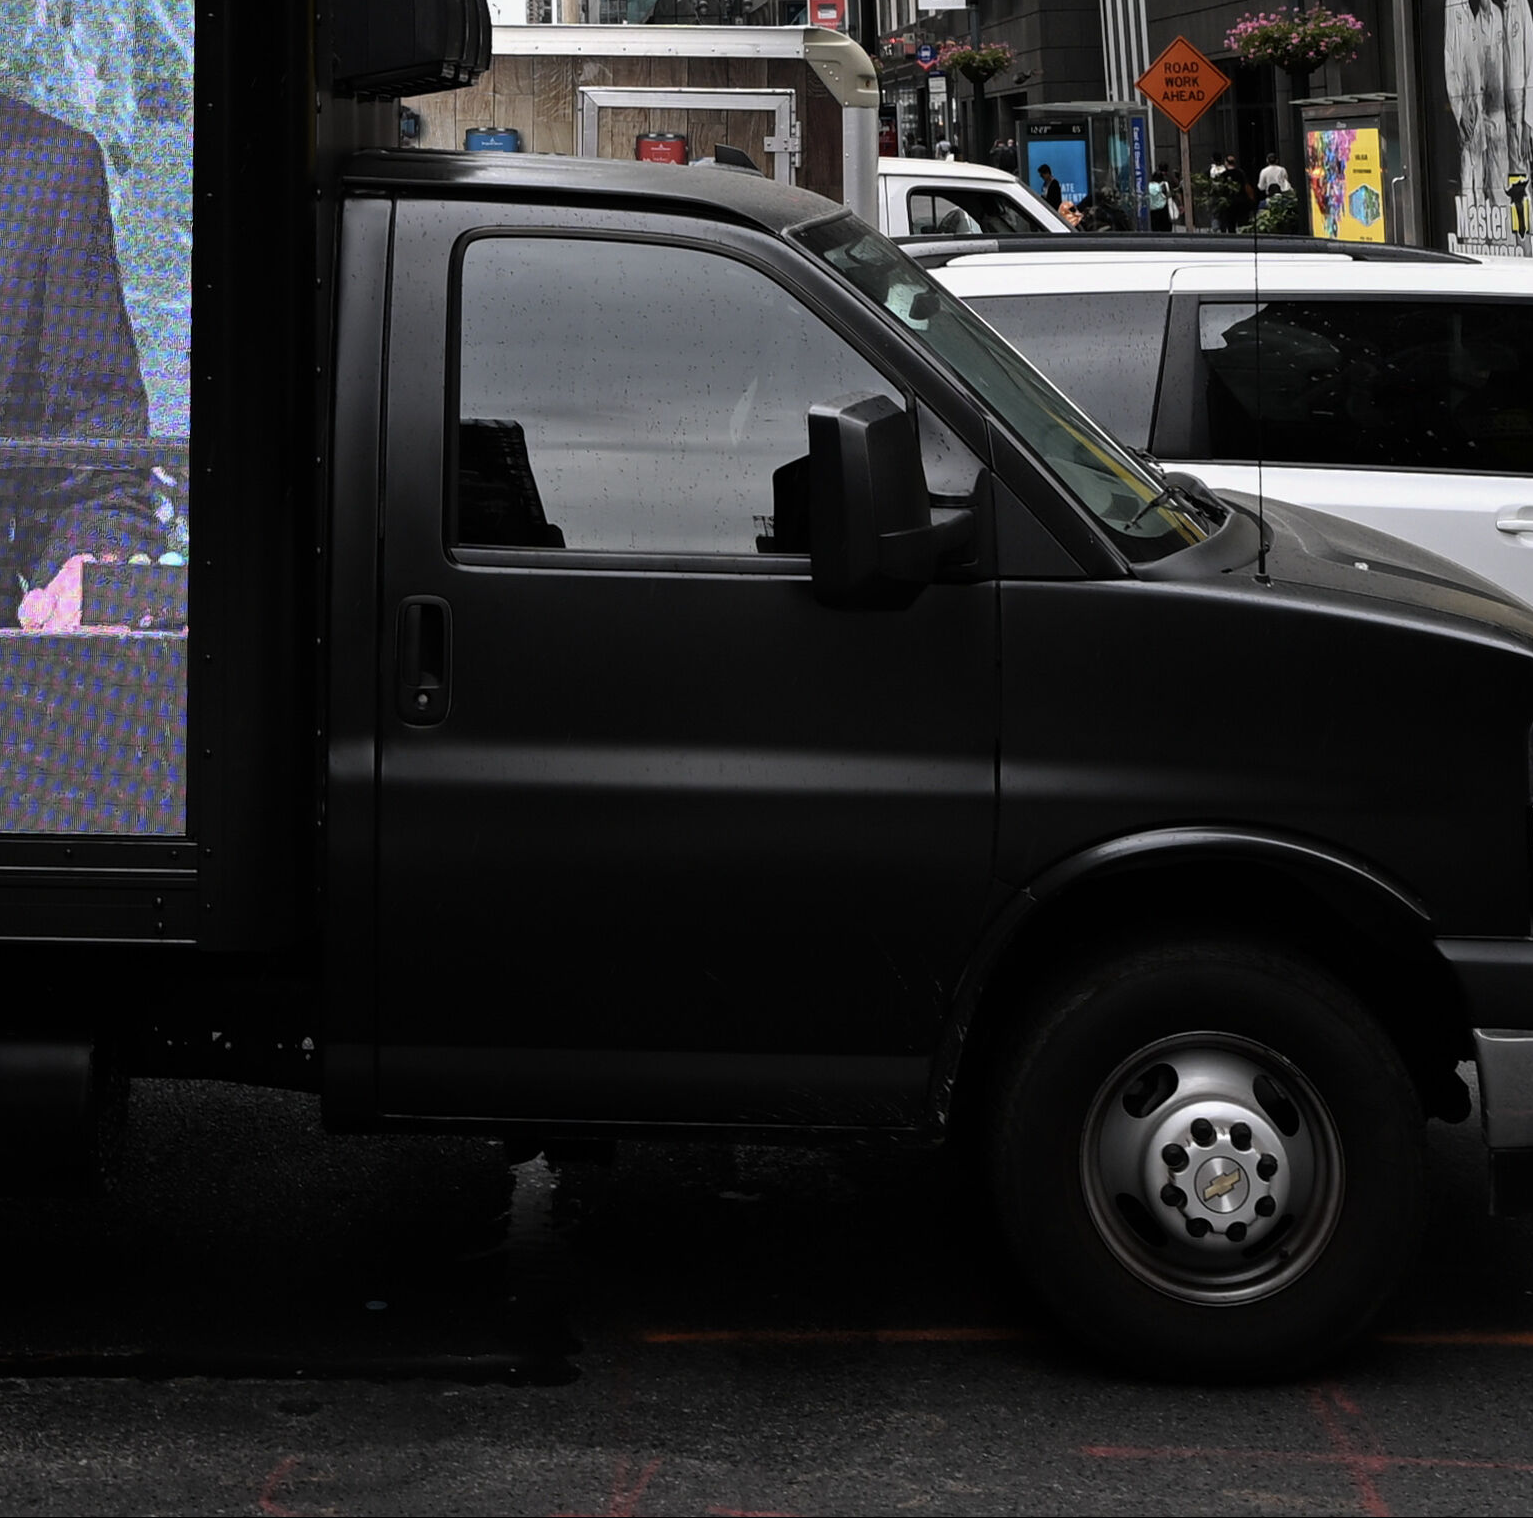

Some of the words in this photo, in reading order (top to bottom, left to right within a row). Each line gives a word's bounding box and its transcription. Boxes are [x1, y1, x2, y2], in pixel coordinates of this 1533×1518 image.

[1164, 61, 1199, 74] ROAD
[1164, 76, 1200, 88] WORK
[1162, 90, 1205, 102] AHEAD
[1454, 195, 1507, 240] Master
